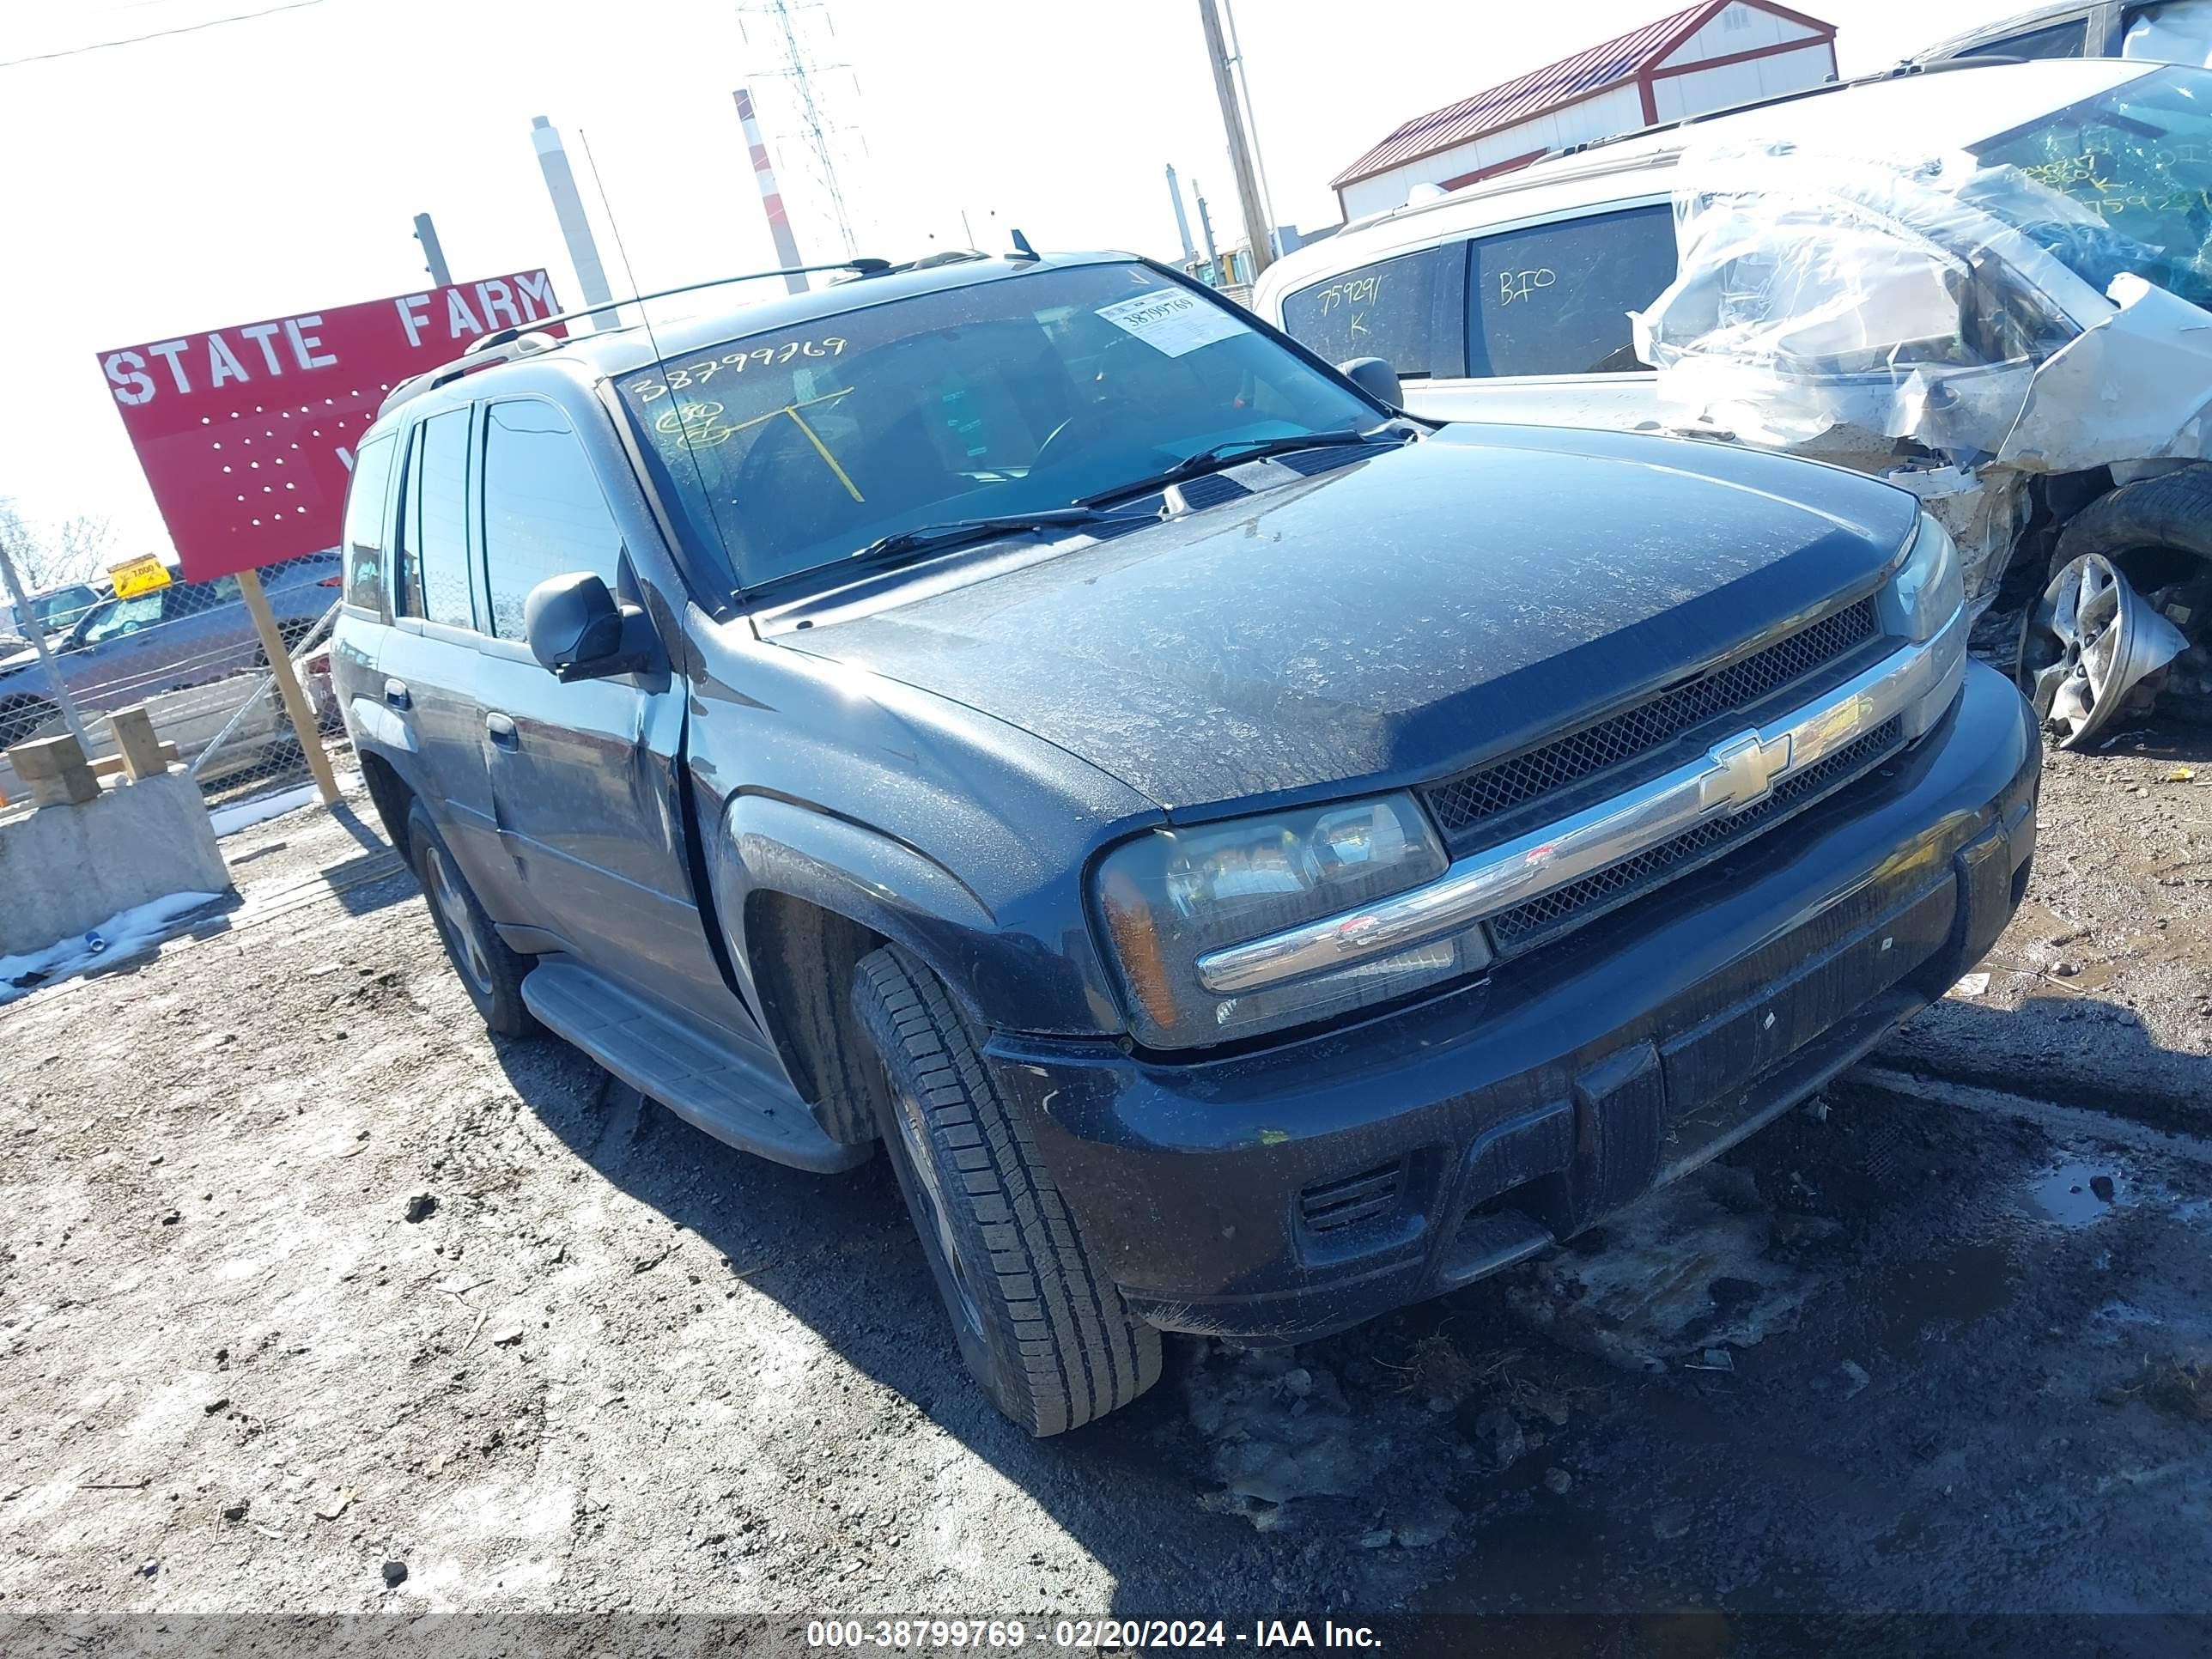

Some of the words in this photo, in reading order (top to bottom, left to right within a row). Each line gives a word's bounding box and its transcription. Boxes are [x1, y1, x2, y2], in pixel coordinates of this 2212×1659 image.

[1123, 298, 1194, 327] 38799769
[1350, 311, 1368, 337] K
[104, 314, 337, 405] STATE
[394, 271, 560, 347] FARM
[631, 337, 848, 403] 38799769
